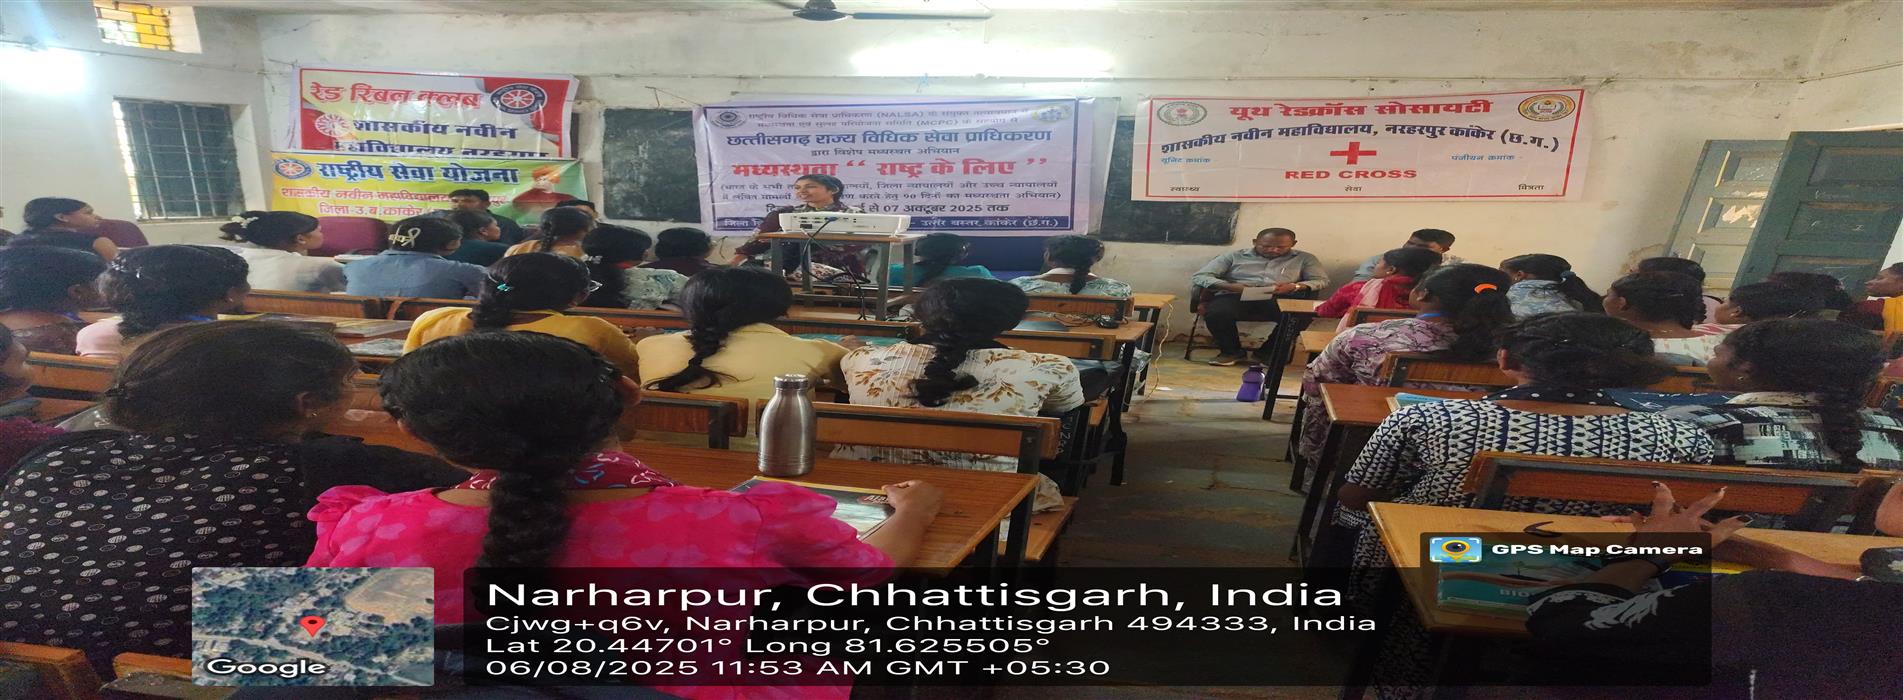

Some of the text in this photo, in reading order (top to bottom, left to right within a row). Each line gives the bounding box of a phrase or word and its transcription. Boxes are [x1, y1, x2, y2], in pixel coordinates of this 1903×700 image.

[310, 82, 344, 102] रेड
[876, 110, 924, 119] (NALSA)
[1229, 99, 1493, 121] यूथ रेडक्रॉस सोसायटी
[352, 119, 518, 139] शासकीय नवीन
[726, 128, 1052, 146] छत्तीसगढ़ राज्य विधिक सेवा प्राधिकरण
[1161, 133, 1226, 154] शासकीय
[1230, 127, 1274, 141] नवीन
[1384, 123, 1447, 138] नरहरपुर
[1449, 124, 1496, 140] कांकेर
[917, 146, 960, 154] अभियान
[316, 160, 384, 182] राष्ट्रीय
[389, 162, 434, 181] सेवा
[440, 162, 519, 184] योजना
[732, 163, 838, 177] मध्यस्थता
[876, 162, 925, 178] राष्ट्र
[929, 158, 956, 175] के
[961, 158, 1016, 175] लिए
[1285, 169, 1417, 179] RED CROSS
[335, 188, 373, 199] नवीन
[319, 202, 349, 214] जिला
[869, 203, 880, 212] से
[883, 204, 899, 212] 07
[904, 204, 946, 214] अक्टूबर
[950, 204, 983, 212] 2025
[986, 204, 1010, 212] तक
